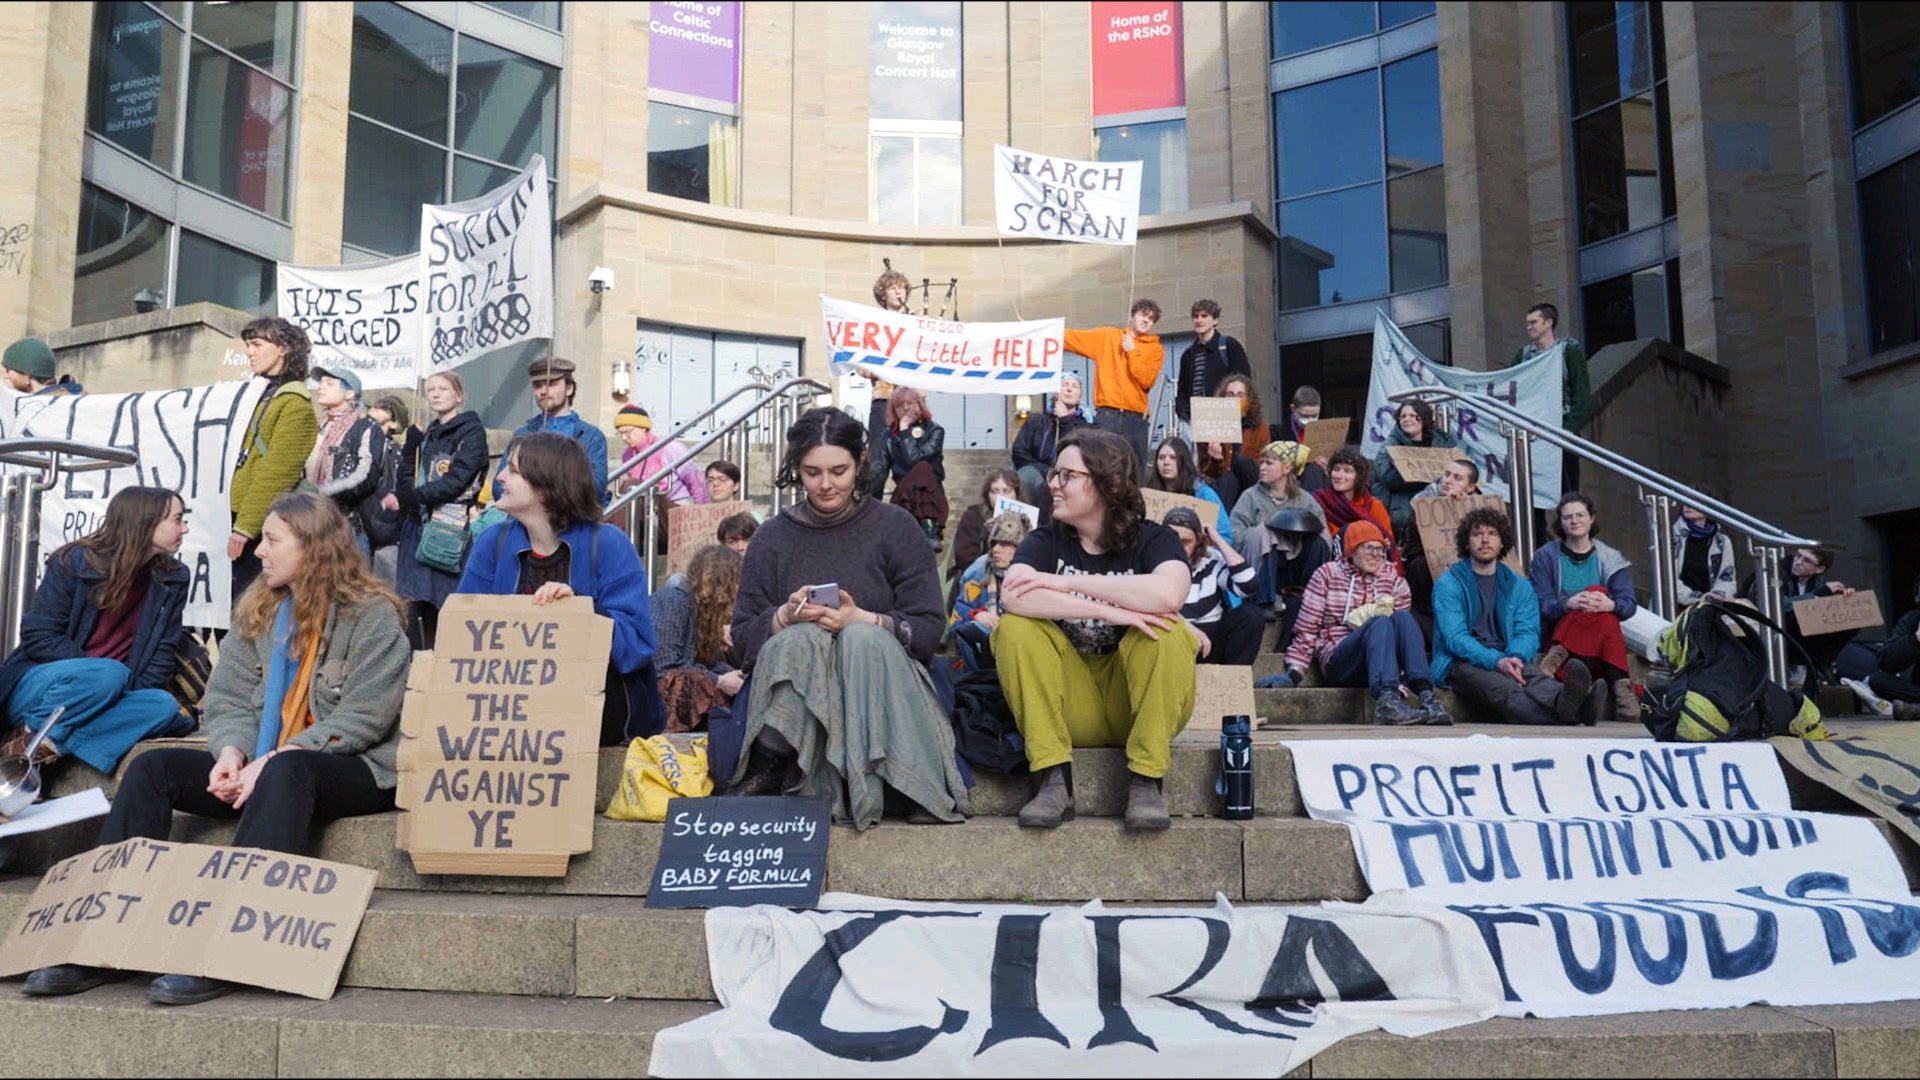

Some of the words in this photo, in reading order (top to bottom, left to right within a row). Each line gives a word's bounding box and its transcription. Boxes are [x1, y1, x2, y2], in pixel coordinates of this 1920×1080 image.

[664, 2, 704, 13] ome
[707, 6, 721, 16] of
[673, 11, 711, 30] Celtic
[1111, 15, 1150, 28] Home
[1153, 9, 1168, 22] of
[650, 20, 734, 48] Connections
[877, 23, 936, 36] Welcome
[941, 26, 954, 37] to
[1108, 31, 1129, 42] the
[1133, 24, 1172, 40] RSNO
[888, 37, 944, 53] Glasgow
[897, 51, 935, 66] Royal
[875, 64, 927, 78] Concert
[930, 66, 956, 79] Hall
[1041, 182, 1087, 212] FOR
[1008, 202, 1126, 240] SCRAN
[287, 287, 363, 316] THIS
[383, 280, 419, 316] IS
[426, 272, 477, 315] FOR
[916, 318, 965, 334] TESCO
[826, 320, 906, 356] VERY
[991, 338, 1060, 369] HELP
[465, 620, 559, 651] YE'VE
[450, 658, 557, 685] TURNED
[467, 693, 528, 722] THE
[437, 726, 566, 766] WEANS
[424, 768, 570, 807] AGAINST
[1333, 758, 1555, 818] PROFIT
[1587, 746, 1707, 813] ISNT
[1720, 762, 1761, 811] A
[468, 810, 516, 849] YE
[672, 811, 735, 837] Stop
[739, 815, 818, 842] security
[92, 840, 170, 874] CAN'T
[196, 850, 338, 895] AFFORD
[703, 842, 784, 868] tagging
[660, 868, 721, 887] BABY
[725, 868, 812, 884] FORMULA
[20, 902, 63, 936] THE
[62, 890, 143, 924] COST
[168, 900, 212, 927] OF
[230, 905, 337, 952] DYING
